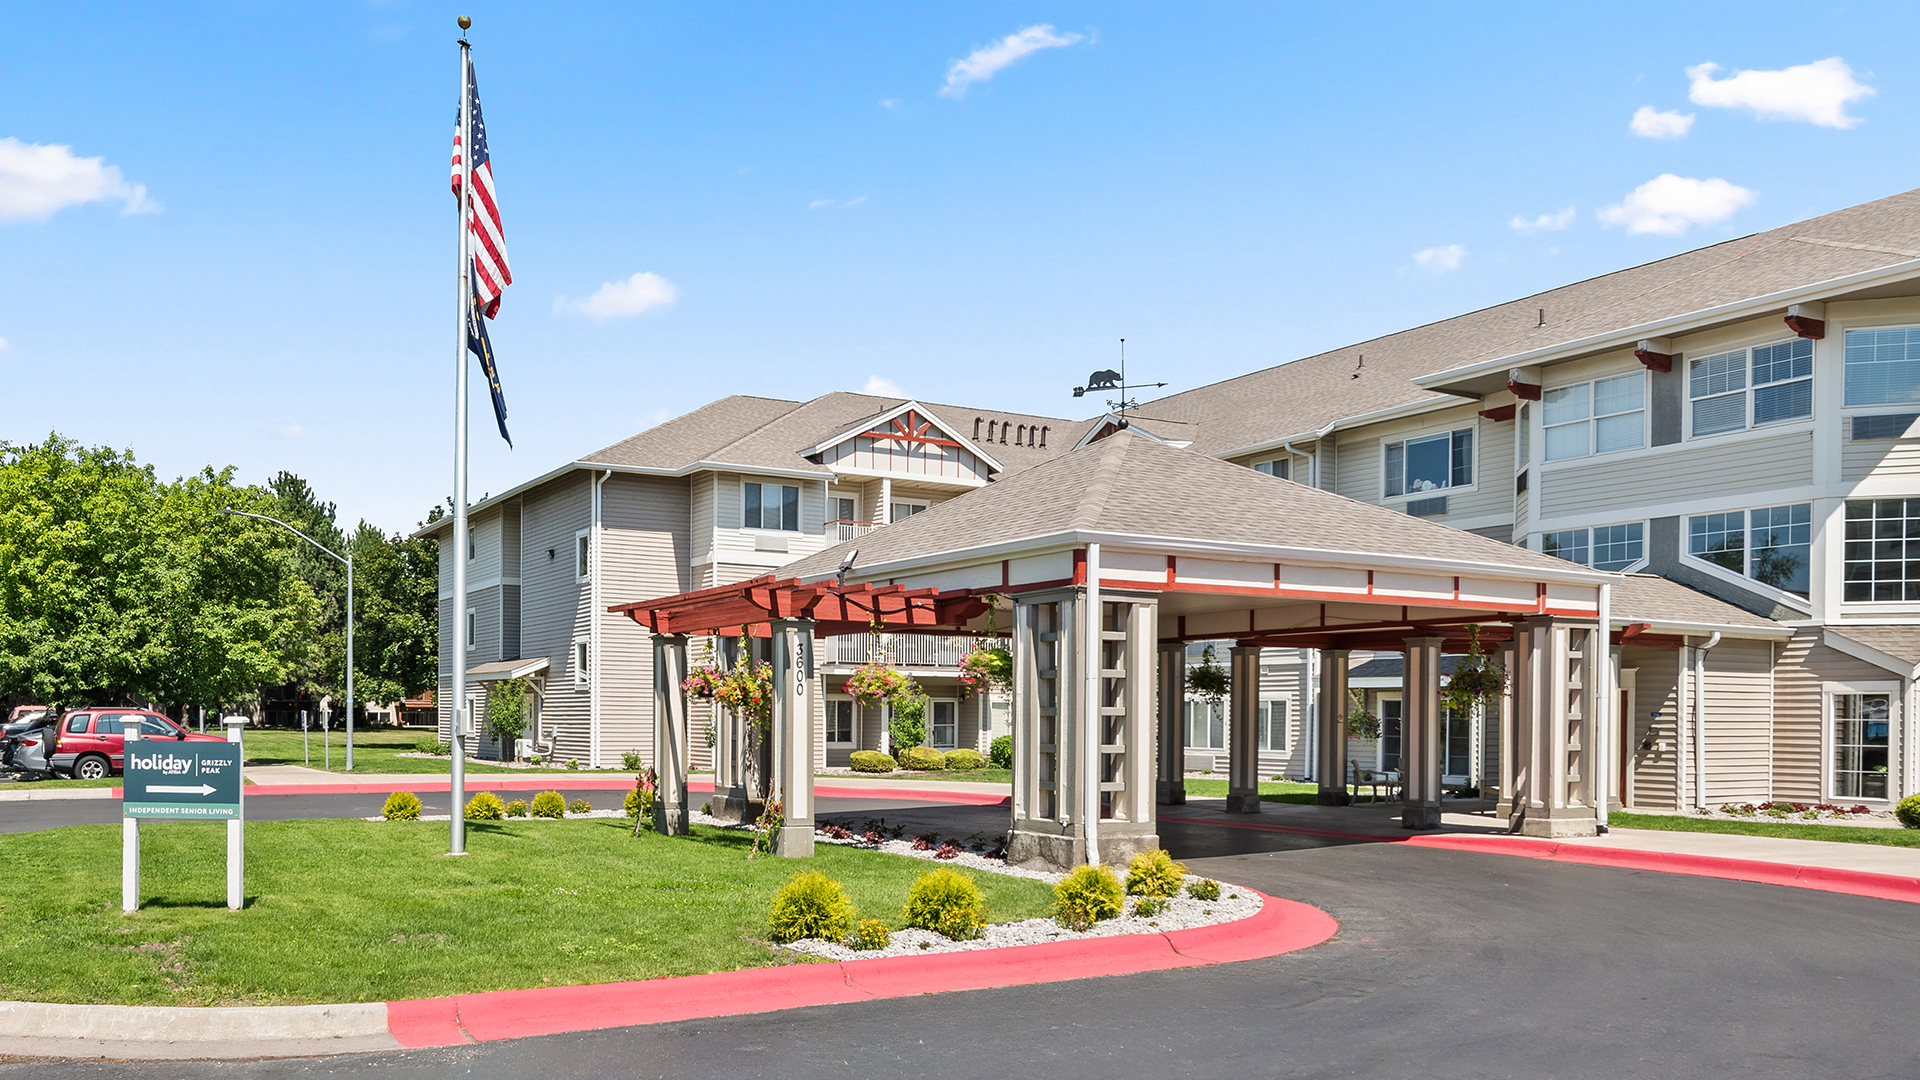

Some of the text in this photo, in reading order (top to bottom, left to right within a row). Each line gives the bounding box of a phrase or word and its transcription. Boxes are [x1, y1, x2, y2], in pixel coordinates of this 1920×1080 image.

[796, 643, 804, 696] 3600
[131, 753, 192, 774] holiday
[181, 807, 207, 815] SENIOR
